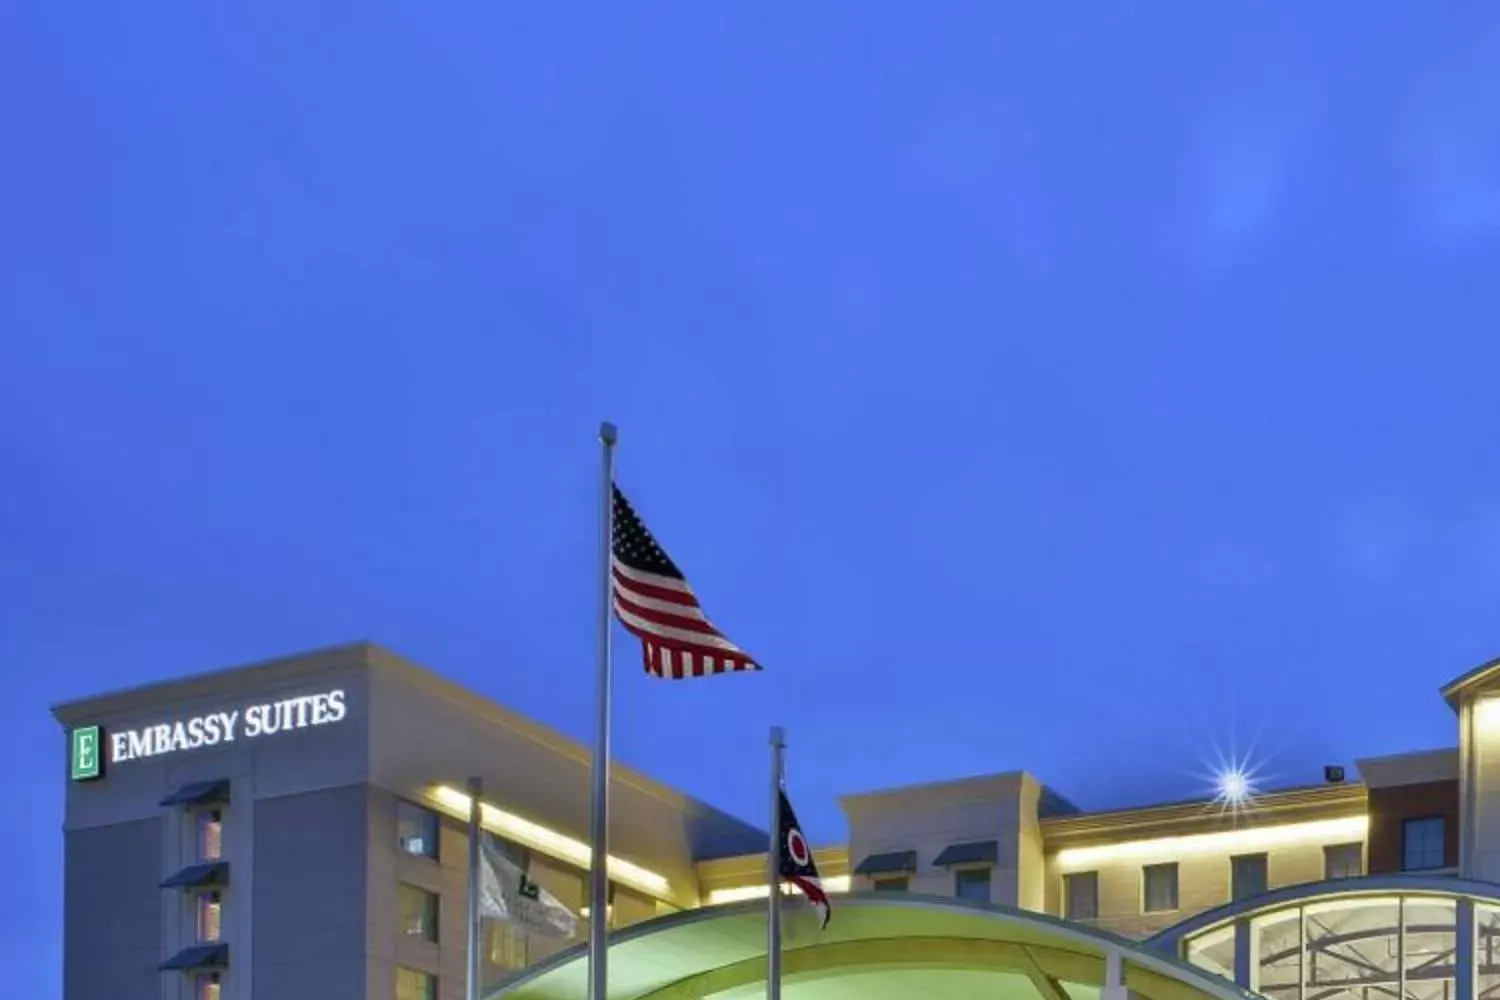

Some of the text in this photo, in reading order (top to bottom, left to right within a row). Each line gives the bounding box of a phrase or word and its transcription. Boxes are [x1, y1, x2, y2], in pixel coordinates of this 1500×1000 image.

[79, 690, 346, 769] E EMBASSY SUITES
